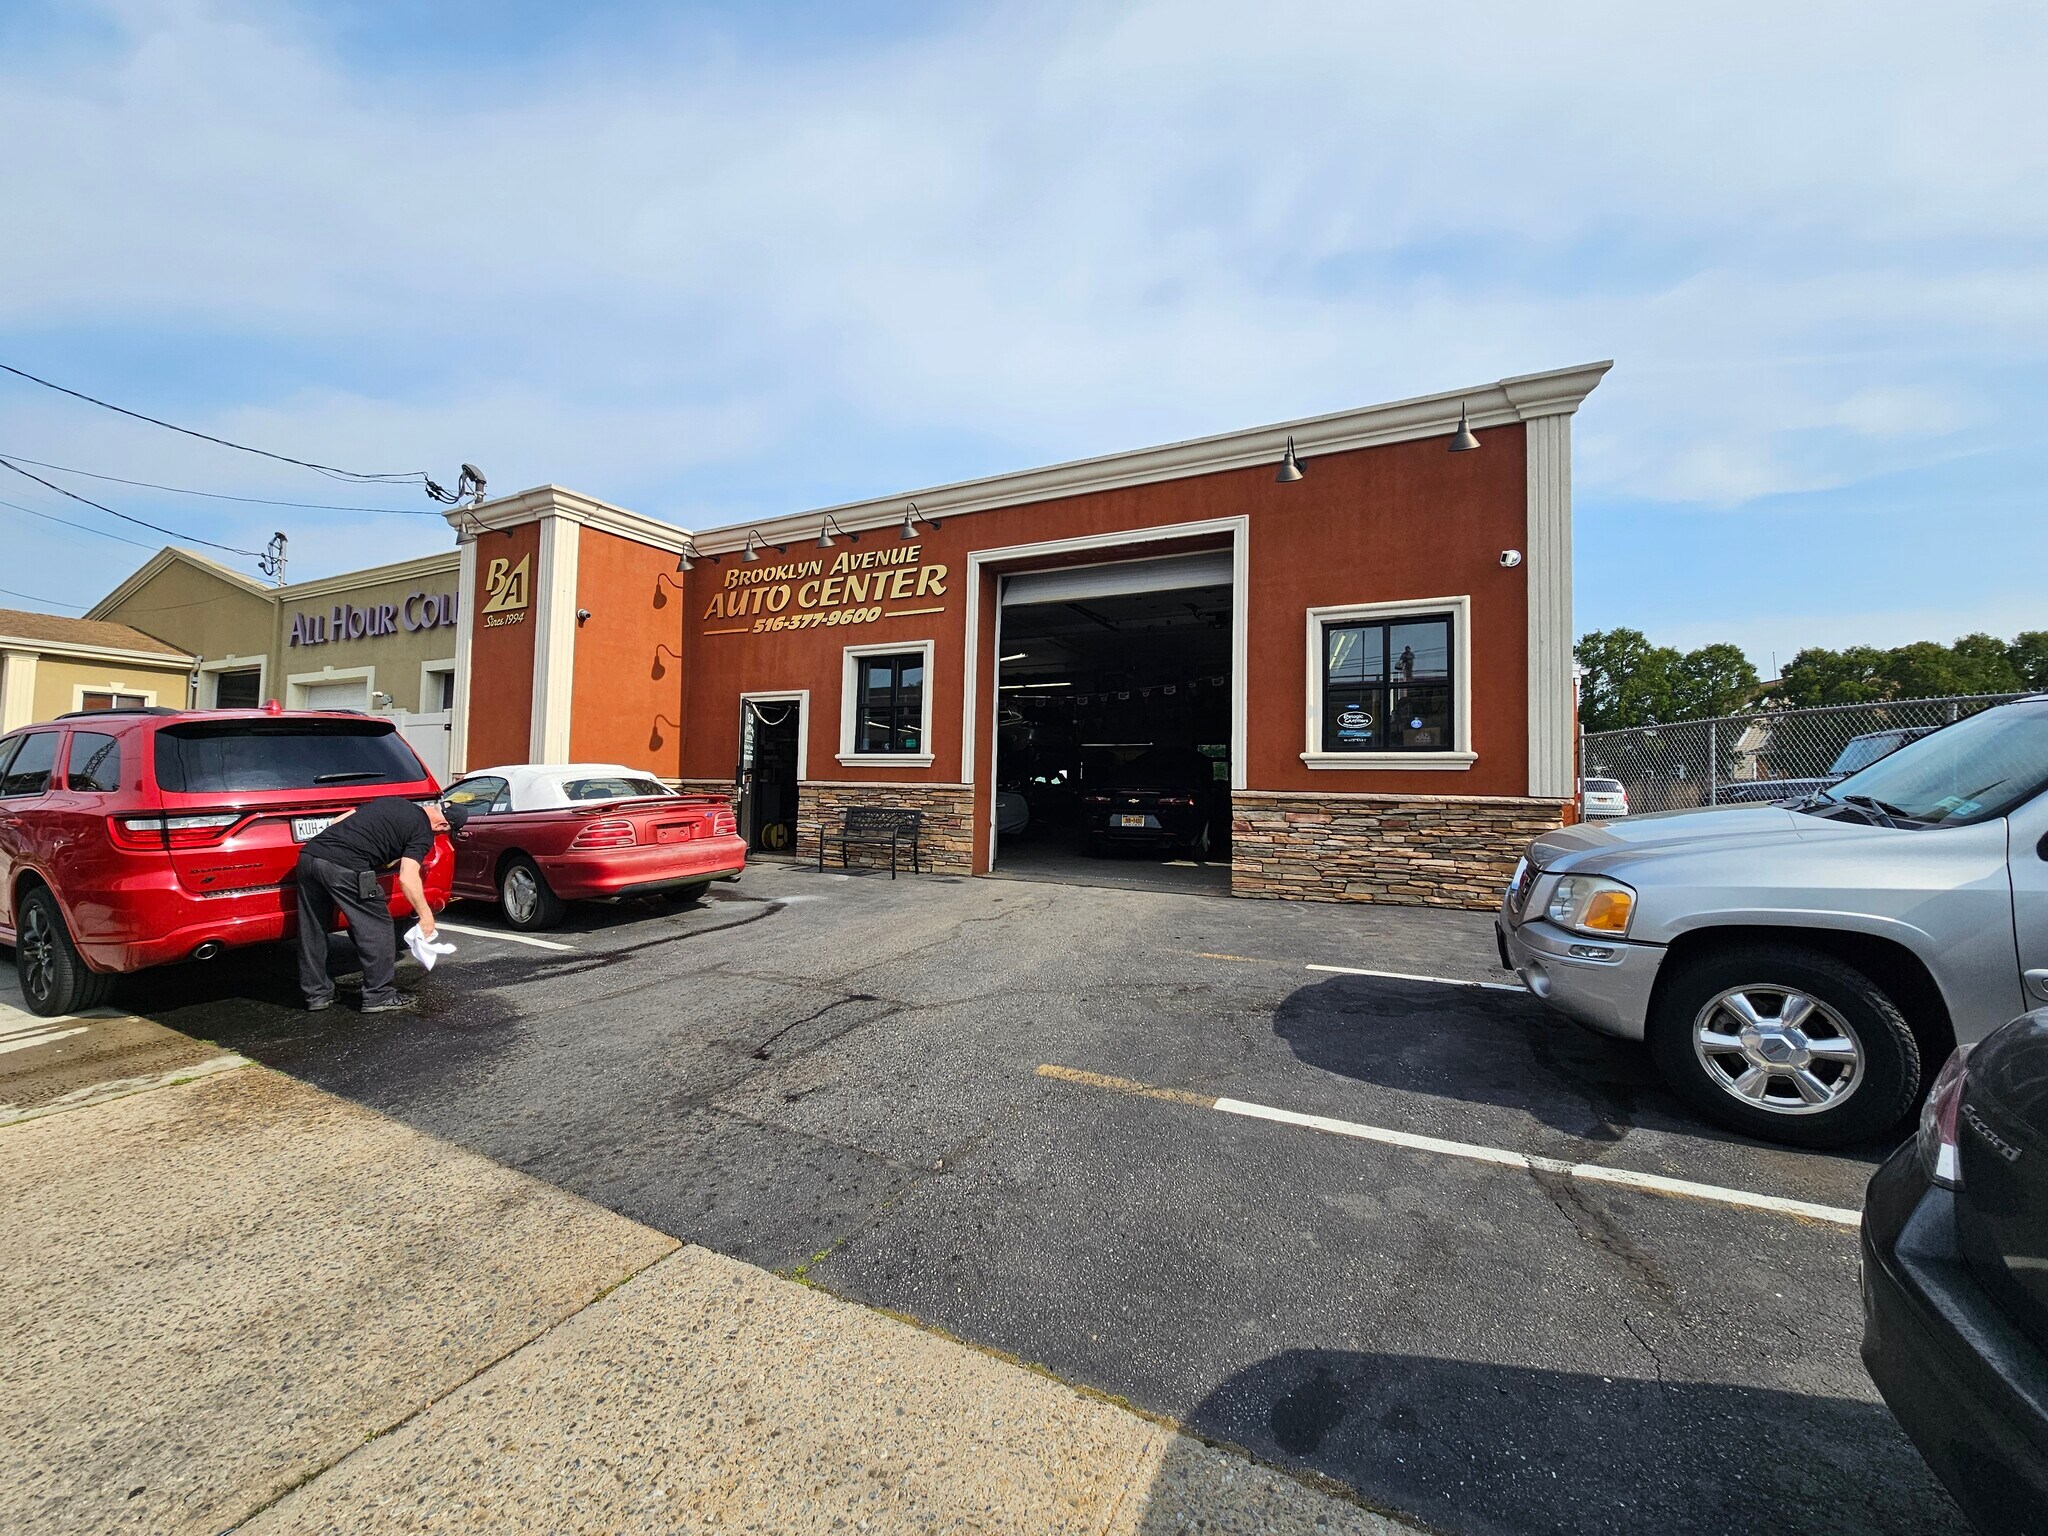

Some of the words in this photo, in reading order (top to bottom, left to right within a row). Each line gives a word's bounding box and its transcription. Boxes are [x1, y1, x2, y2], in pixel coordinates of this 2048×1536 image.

[724, 560, 823, 589] BROOKLYN
[829, 545, 922, 575] AVENUE
[703, 584, 792, 620] AUTO
[798, 564, 948, 608] CENTER
[289, 612, 328, 648] ALL
[330, 603, 398, 641] HOUR
[484, 614, 504, 628] Since
[505, 612, 525, 625] 1994
[752, 606, 882, 634] 516-377-9600
